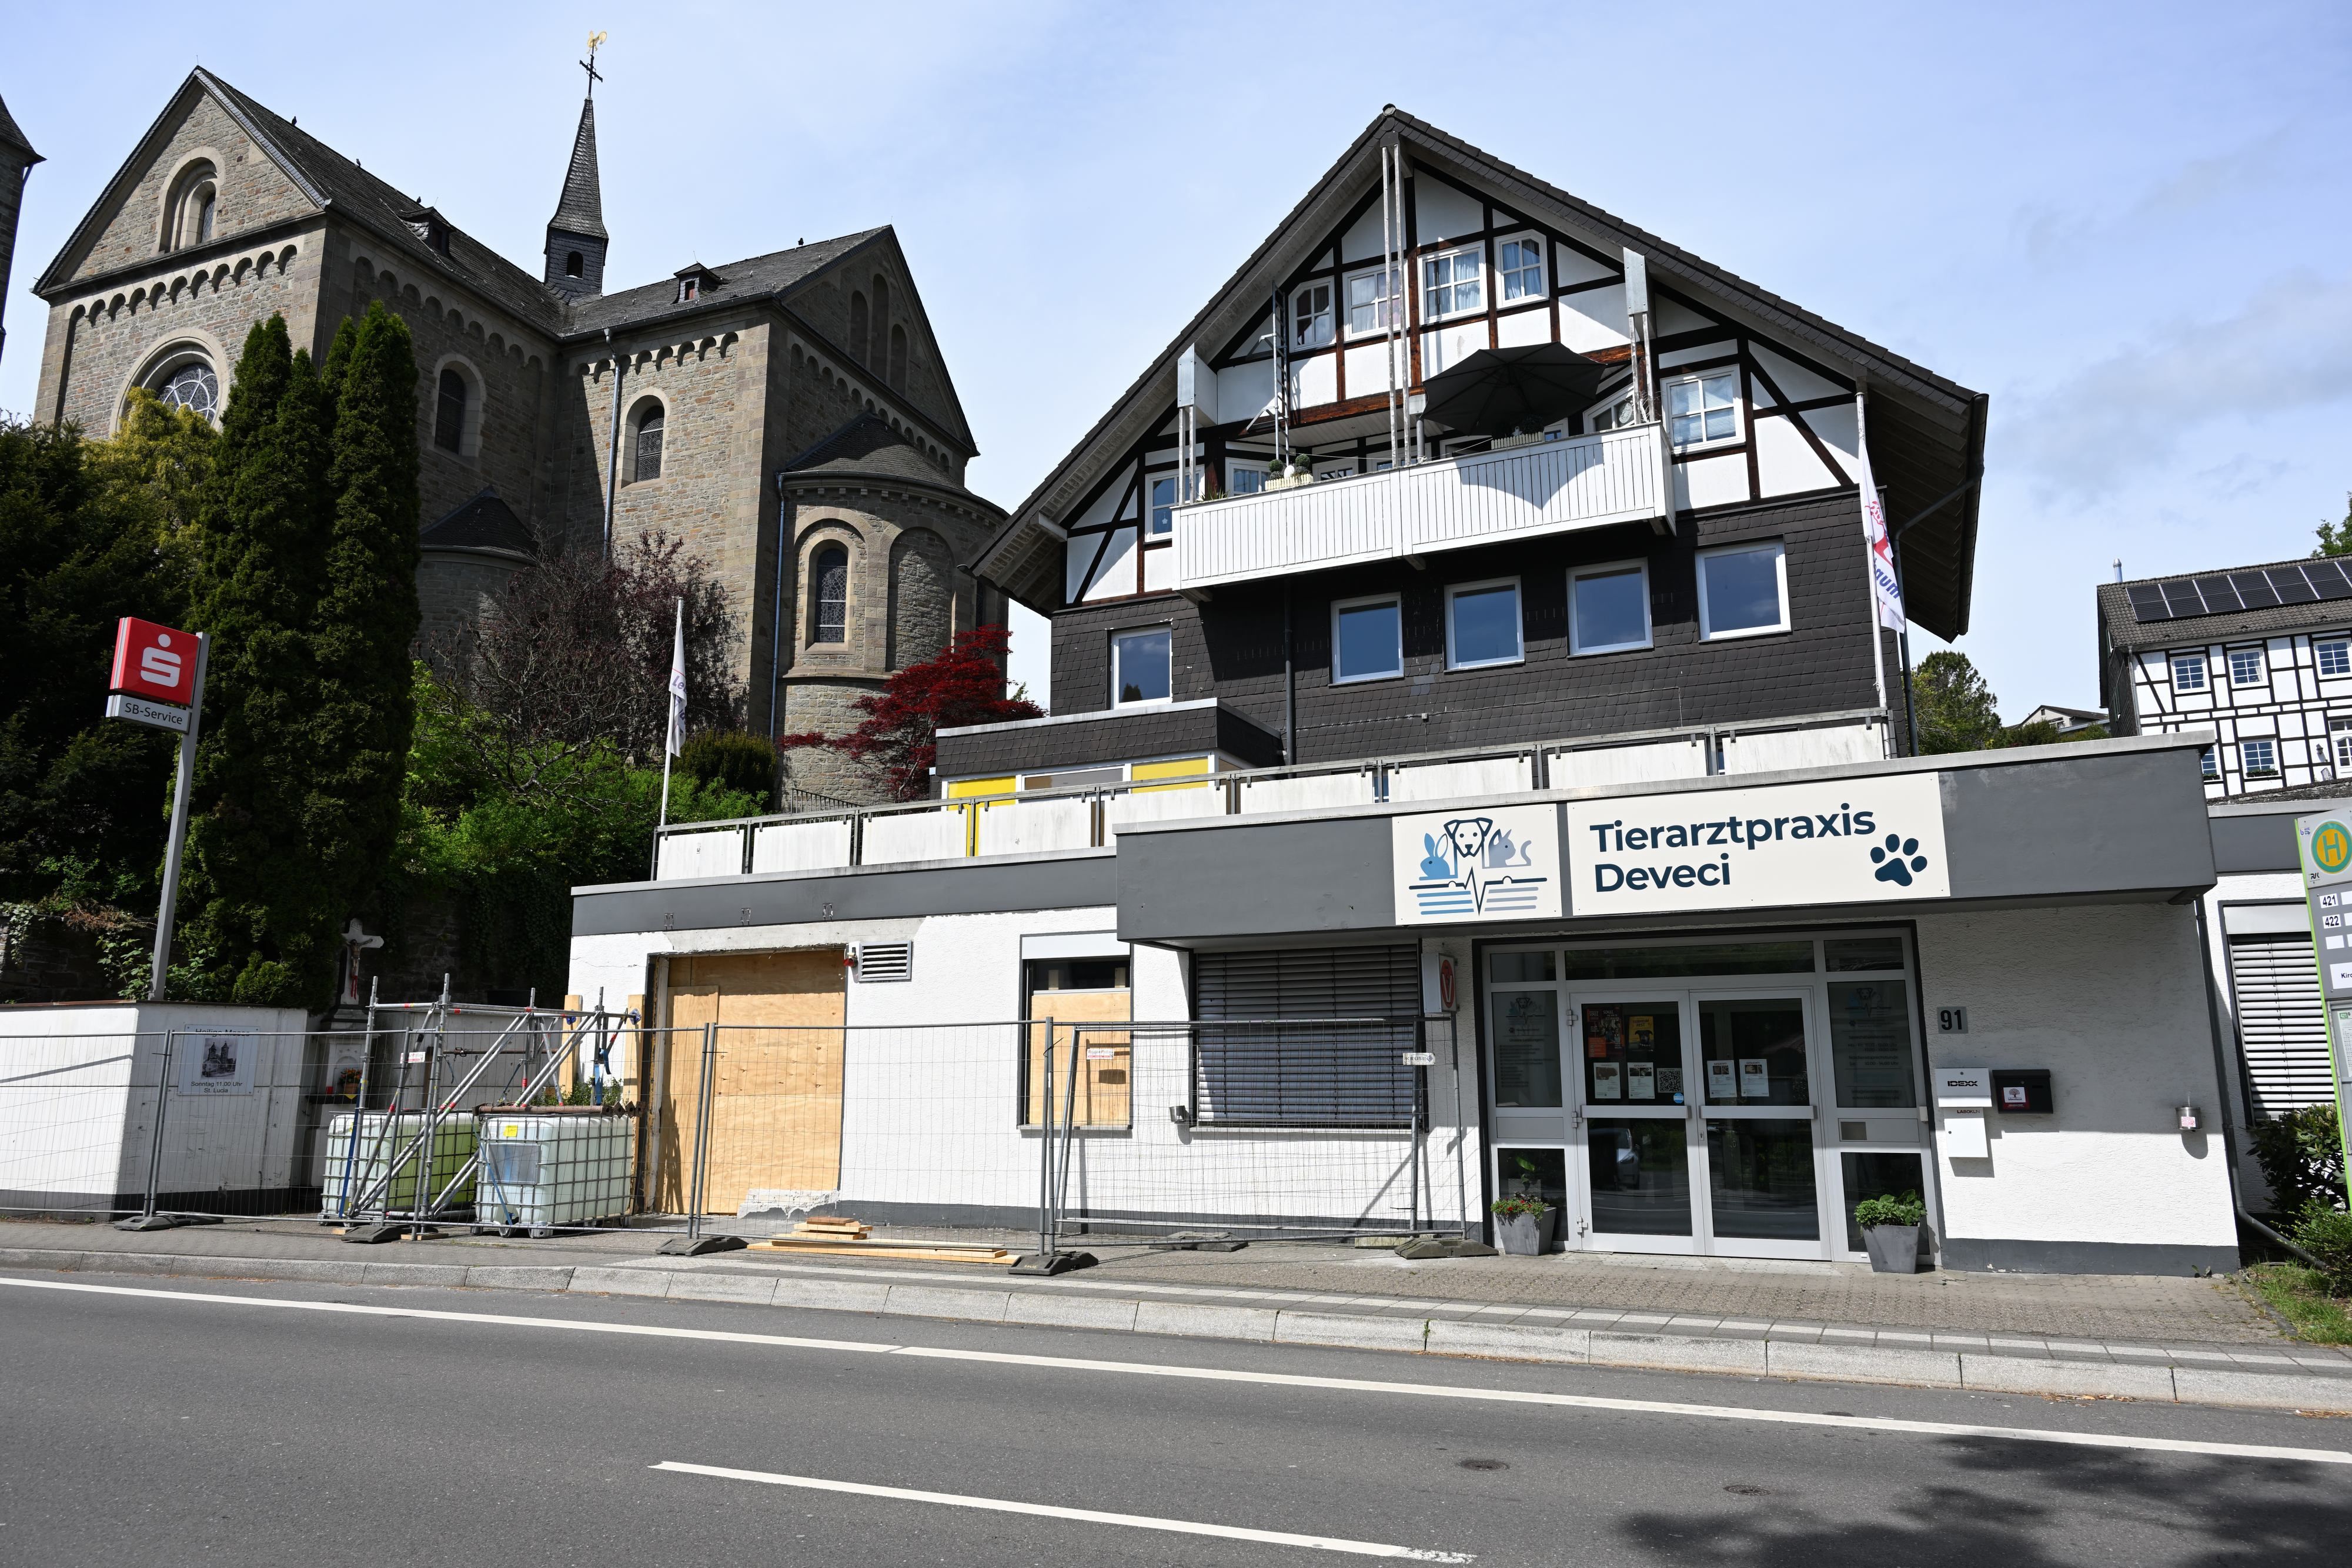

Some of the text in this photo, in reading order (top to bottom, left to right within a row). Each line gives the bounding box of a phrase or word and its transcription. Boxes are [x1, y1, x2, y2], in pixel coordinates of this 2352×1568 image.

[125, 703, 183, 725] SB-Service
[1589, 803, 1876, 852] Tierarztpraxis
[2323, 833, 2341, 862] H
[1595, 852, 1730, 892] Deveci
[2323, 895, 2336, 907] 421
[2325, 915, 2340, 927] 422
[1940, 1009, 1962, 1031] 91
